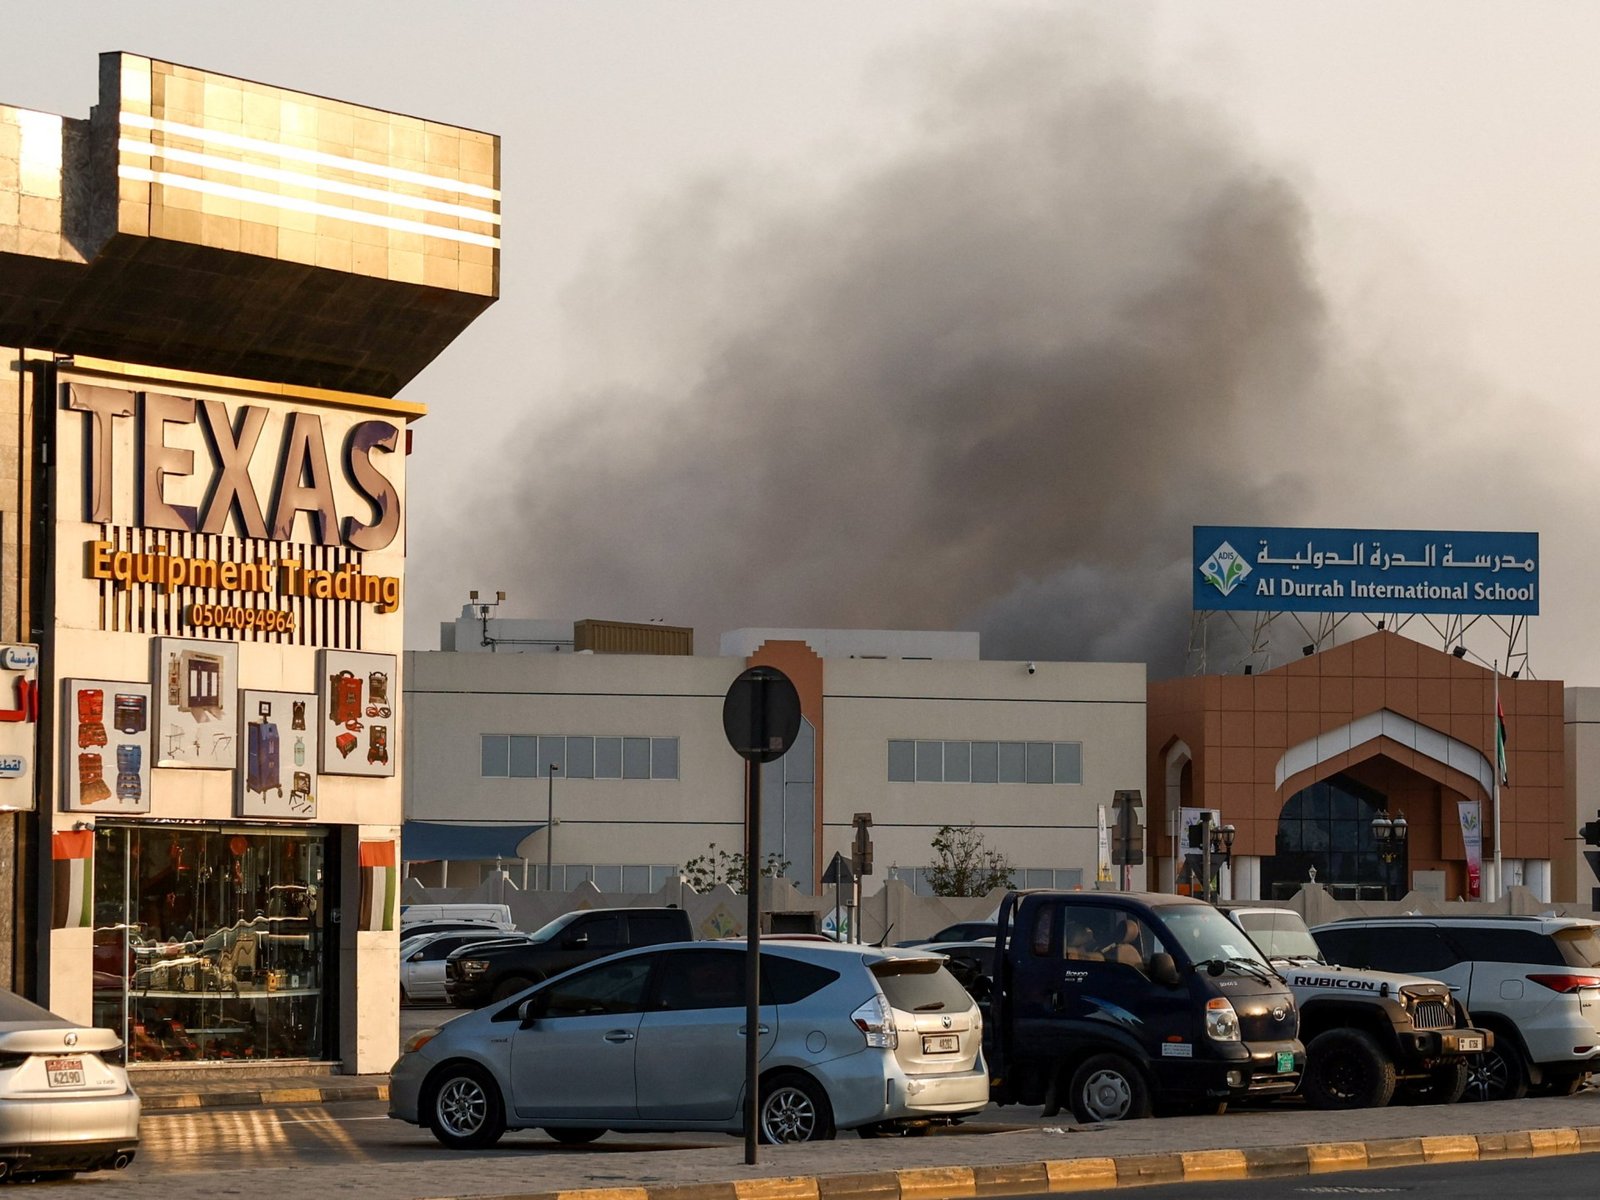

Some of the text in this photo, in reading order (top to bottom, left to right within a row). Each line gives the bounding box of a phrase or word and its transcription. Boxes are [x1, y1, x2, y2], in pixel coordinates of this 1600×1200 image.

[59, 382, 399, 550] TEXAS
[1218, 552, 1234, 560] ADIS
[1257, 540, 1535, 572] مدرسة الدرة الدولية
[92, 541, 399, 612] Equipment Trading
[1256, 578, 1534, 600] Al Durrah International School
[190, 603, 295, 632] 0504094964
[1294, 976, 1374, 990] RUBICON
[54, 1071, 80, 1084] 42190
